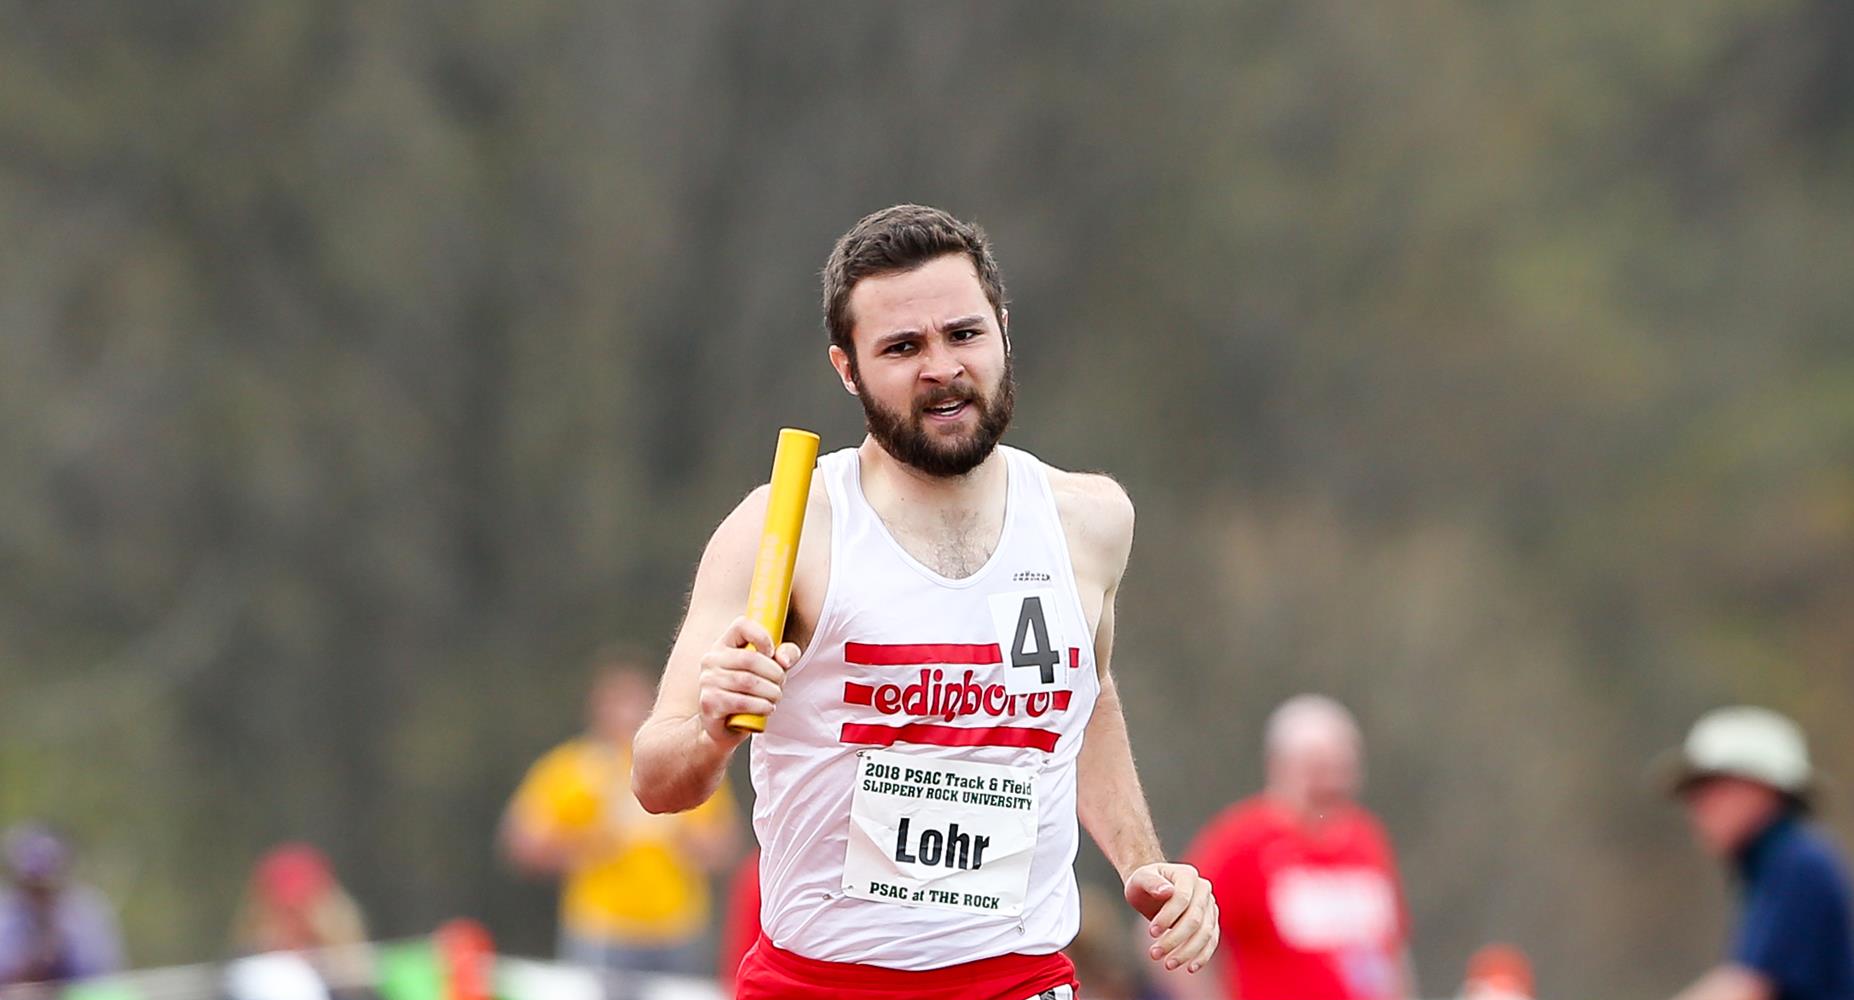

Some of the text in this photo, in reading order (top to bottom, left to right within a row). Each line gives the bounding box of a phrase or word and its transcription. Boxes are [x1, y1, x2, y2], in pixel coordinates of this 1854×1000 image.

[1010, 596, 1060, 684] 4
[863, 780, 1033, 810] SLIPPERY ROCK UNIVERSITY
[865, 763, 1032, 795] 2018 PSAC Track & Field
[895, 817, 990, 870] Lohr
[869, 882, 1000, 910] PSAC at THE ROCK
